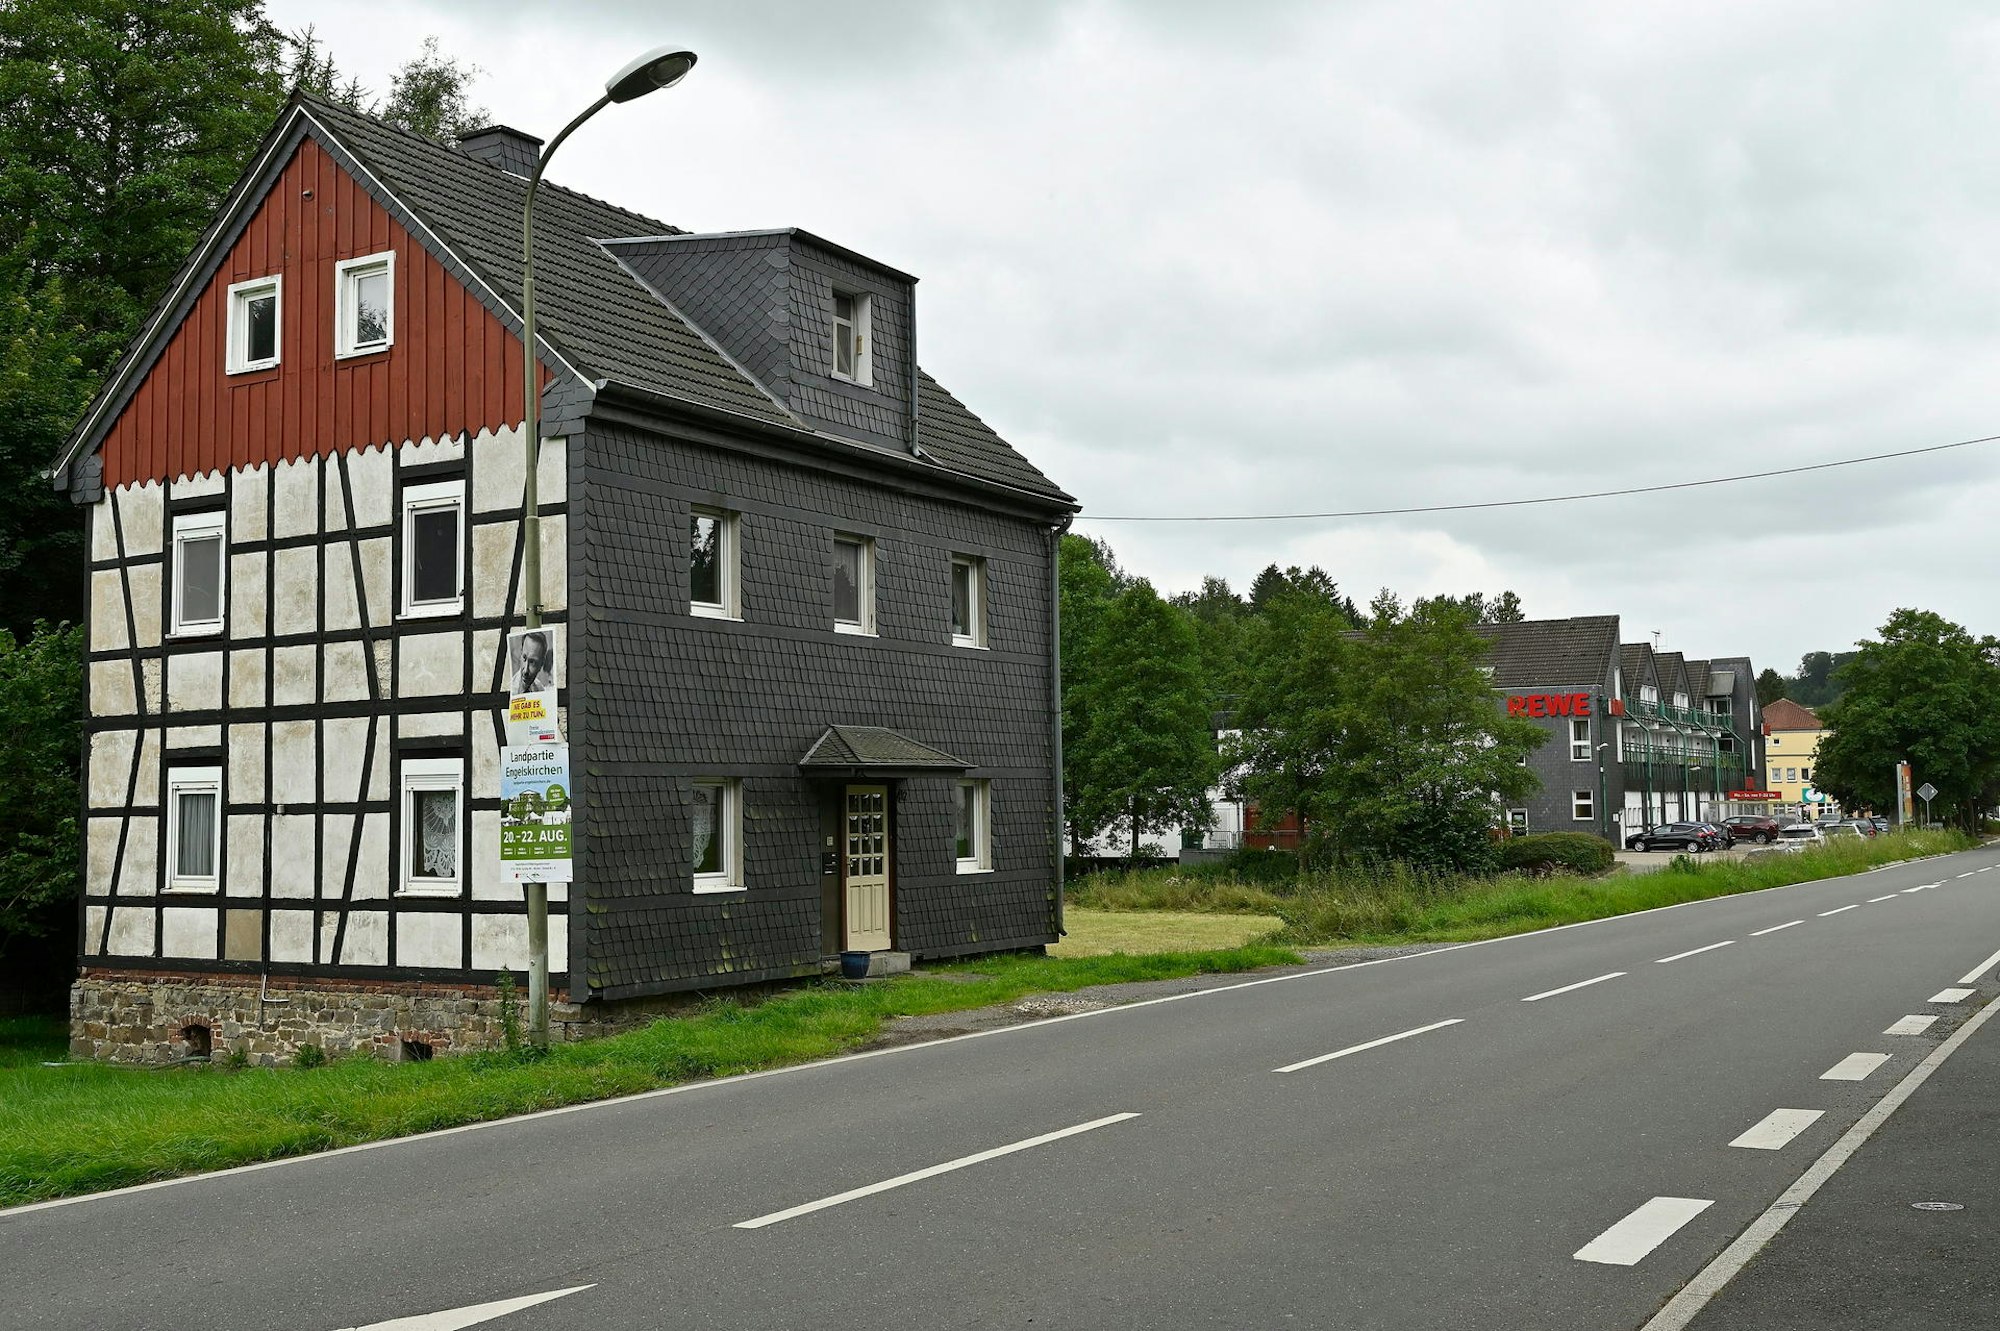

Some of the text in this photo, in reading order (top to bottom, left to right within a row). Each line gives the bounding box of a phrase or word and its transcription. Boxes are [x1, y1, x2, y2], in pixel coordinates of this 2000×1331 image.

[521, 701, 531, 710] GAB
[533, 700, 540, 708] ES
[1507, 693, 1591, 718] REWE
[511, 750, 554, 763] Landpartie
[506, 765, 563, 780] Engelskirchen
[539, 830, 567, 842] AUG.
